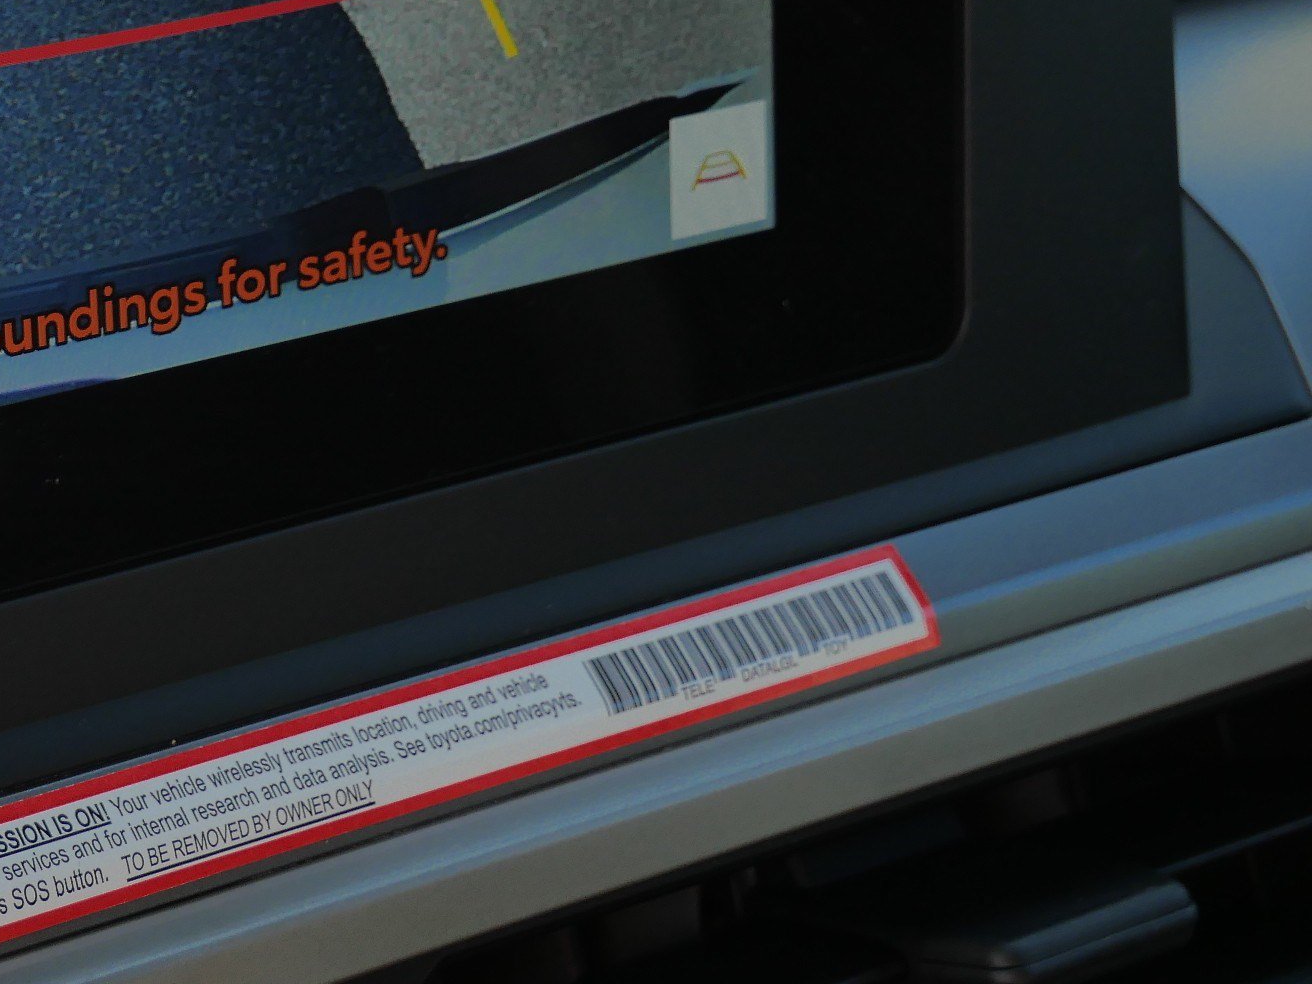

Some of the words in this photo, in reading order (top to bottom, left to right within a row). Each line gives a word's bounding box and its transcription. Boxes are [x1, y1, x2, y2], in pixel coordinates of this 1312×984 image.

[214, 251, 290, 310] for
[295, 223, 450, 291] safety.
[2, 847, 70, 881] services
[72, 833, 104, 859] and
[104, 827, 128, 849] for
[128, 806, 191, 842] internal
[191, 787, 263, 820] research
[261, 776, 294, 801] and
[292, 768, 329, 791] data
[330, 747, 396, 781] analysis.
[393, 738, 426, 759] See
[427, 691, 583, 751] toyota.com/privacyvts.
[51, 813, 74, 836] IS
[75, 802, 112, 828] ON!
[109, 794, 149, 817] Your
[150, 775, 207, 806] vehicle
[207, 752, 283, 789] wirelessly
[282, 732, 353, 765] transmits
[351, 715, 418, 745] location,
[417, 697, 468, 726] driving
[468, 686, 498, 710] and
[497, 672, 550, 700] vehicle
[120, 851, 145, 875] TO
[147, 843, 171, 867] BE
[172, 818, 250, 859] REMOVED
[251, 810, 272, 834] BY
[276, 793, 333, 826] OWNER
[335, 779, 374, 808] ONLY
[11, 879, 51, 909] SOS
[54, 867, 110, 898] button.
